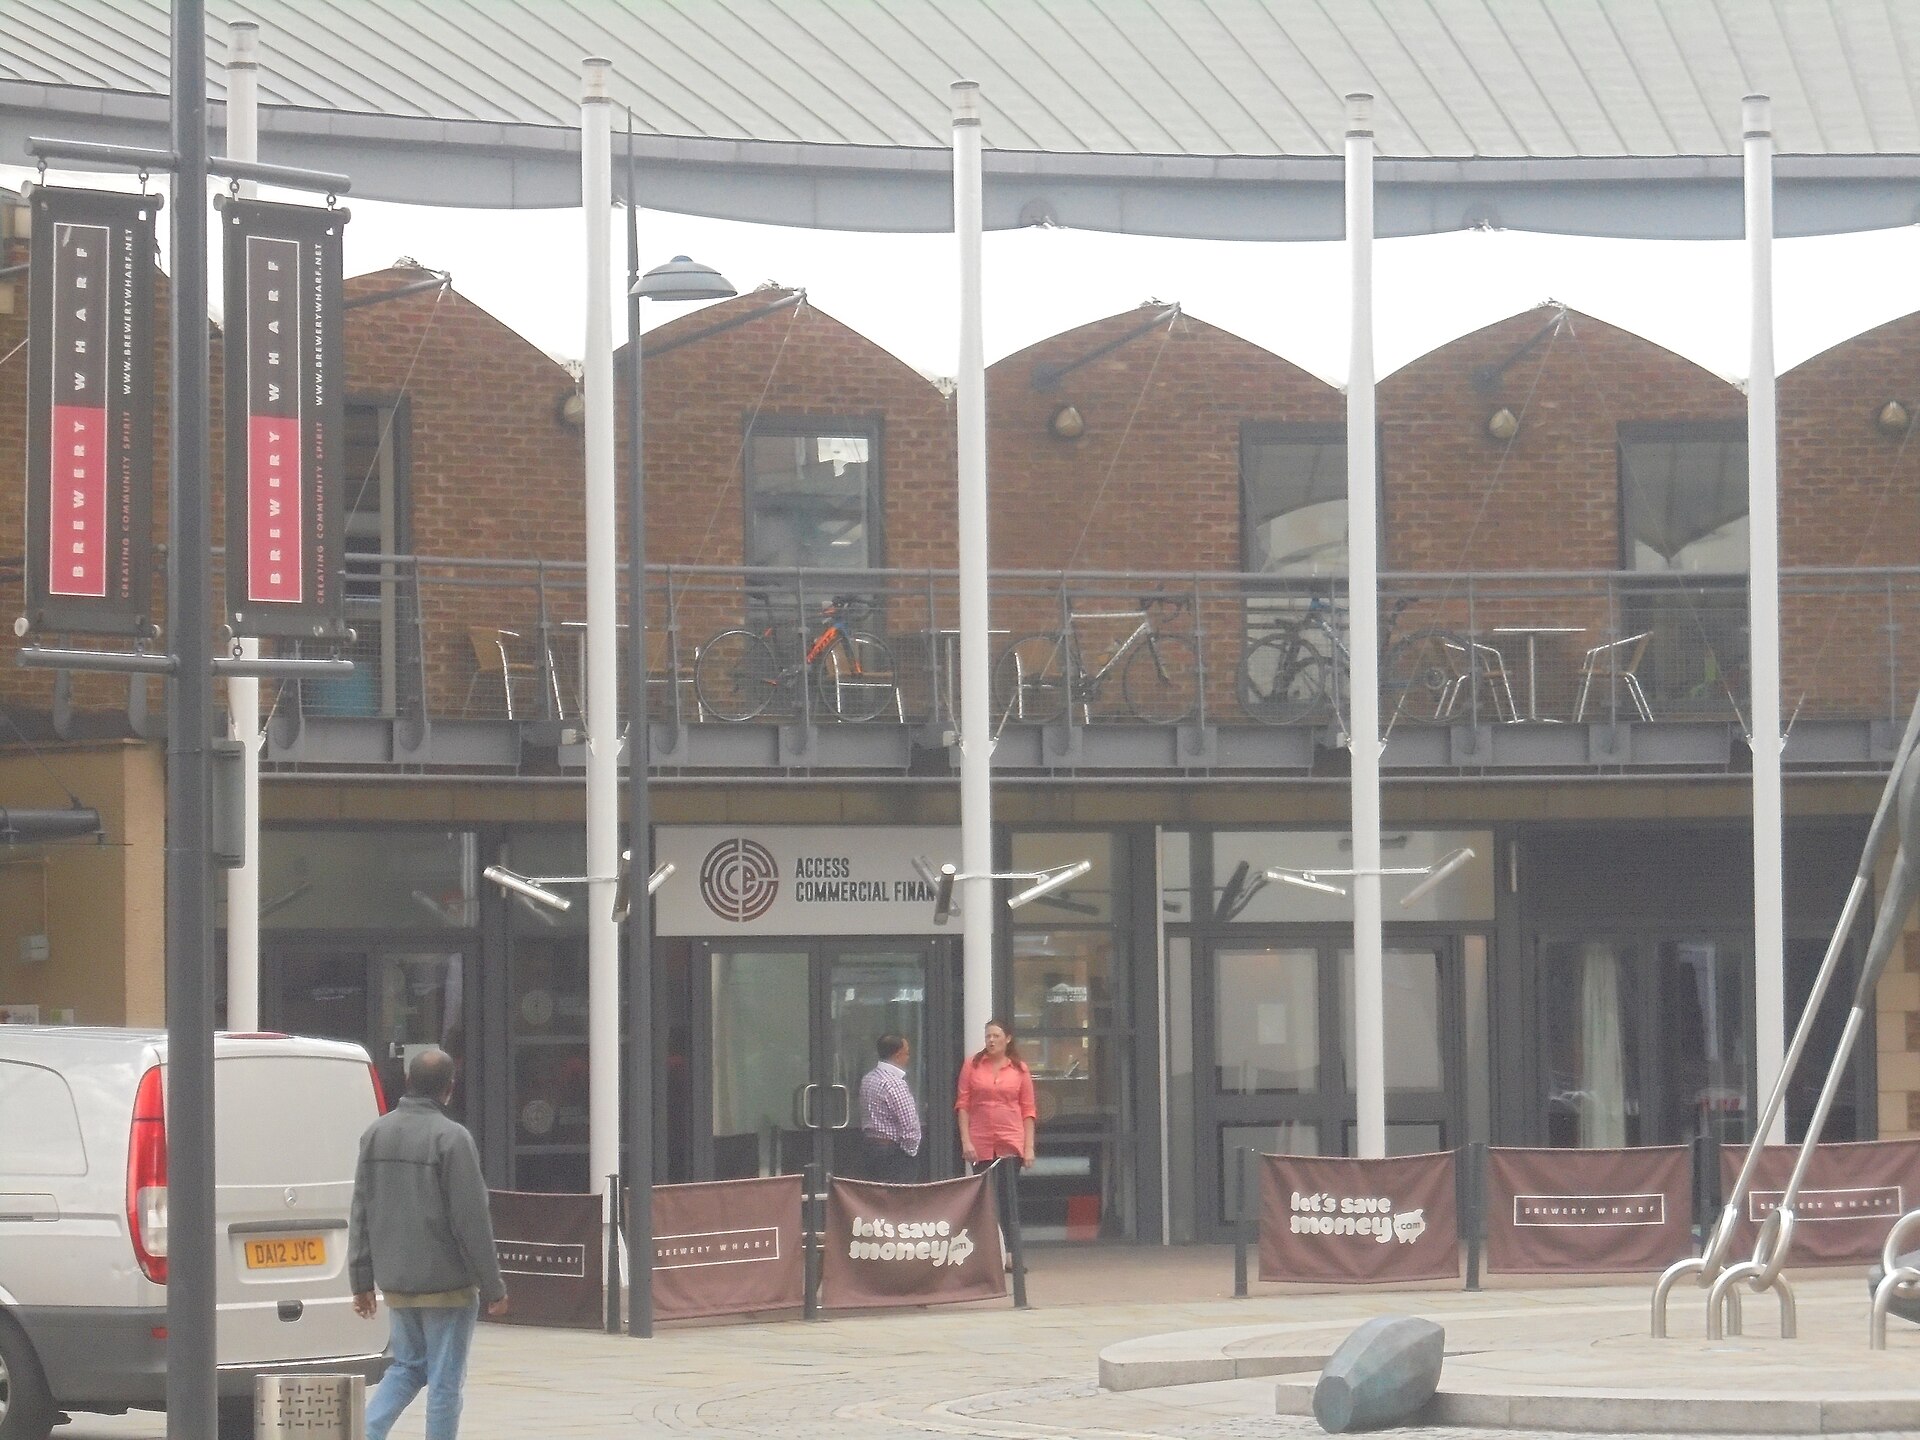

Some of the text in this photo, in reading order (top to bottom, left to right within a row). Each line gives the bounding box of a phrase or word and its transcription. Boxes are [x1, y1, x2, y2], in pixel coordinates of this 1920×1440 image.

[123, 228, 133, 395] WWW.BREWERYWHARF.NET
[315, 243, 323, 406] WWW.BREWERYWHARF.NET
[72, 247, 88, 578] BREWERY WHARF
[267, 261, 281, 584] BREWERY WHARF
[120, 411, 131, 598] CREATING COMMUNITY SPIRIT
[315, 422, 325, 604] CREATING COMMUNITY SPIRIT
[795, 857, 850, 879] ACCESS
[795, 881, 937, 903] COMMERCIAL FINAN
[1290, 1191, 1391, 1214] let's save
[1524, 1205, 1654, 1215] BREWERY WHARF
[1760, 1202, 1823, 1210] BRERY
[852, 1216, 950, 1239] let's save
[1289, 1215, 1392, 1243] money
[291, 1240, 317, 1261] JYC
[496, 1252, 529, 1261] EWERY
[657, 1240, 770, 1257] BREWERY WHARF
[848, 1240, 949, 1267] money
